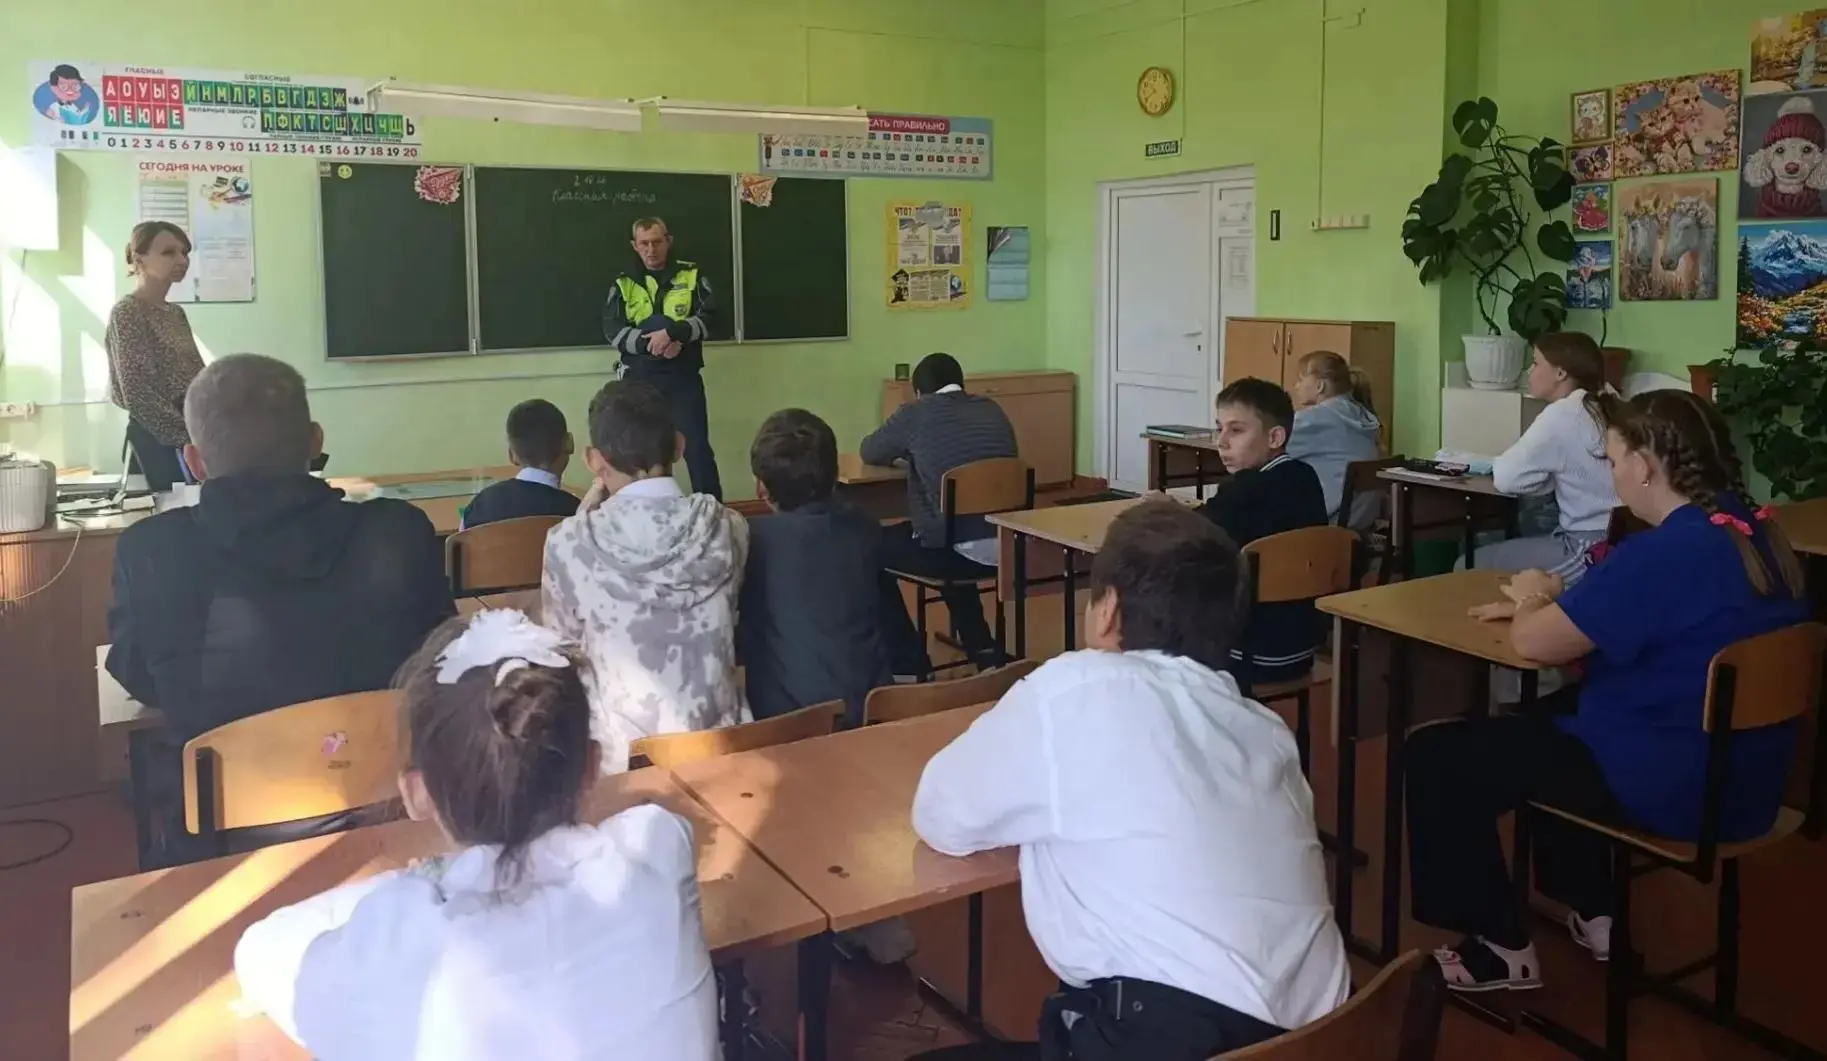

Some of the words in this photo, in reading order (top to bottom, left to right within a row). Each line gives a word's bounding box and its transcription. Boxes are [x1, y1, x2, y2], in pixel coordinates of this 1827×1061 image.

[893, 120, 946, 131] ПРАВИЛЬНО
[107, 136, 116, 147] 0
[120, 138, 128, 148] 1
[132, 138, 141, 148] 2
[144, 139, 153, 149] 3
[156, 140, 165, 149] 4
[169, 140, 177, 150] 5
[181, 140, 191, 150] 6
[193, 141, 201, 150] 7
[205, 141, 214, 151] 8
[217, 141, 226, 151] 9
[229, 142, 244, 152] 10
[248, 142, 261, 152] 11
[265, 143, 279, 153] 12
[283, 143, 297, 154] 13
[301, 143, 315, 154] 14
[318, 145, 333, 155] 15
[336, 146, 350, 156] 16
[354, 147, 367, 156] 17
[370, 147, 384, 157] 18
[387, 147, 400, 157] 19
[403, 148, 418, 158] 20
[1148, 142, 1176, 155] ВЫХОД
[139, 162, 189, 172] СЕГОДНЯ
[191, 164, 208, 172] НА
[210, 164, 245, 173] УРОКЕ
